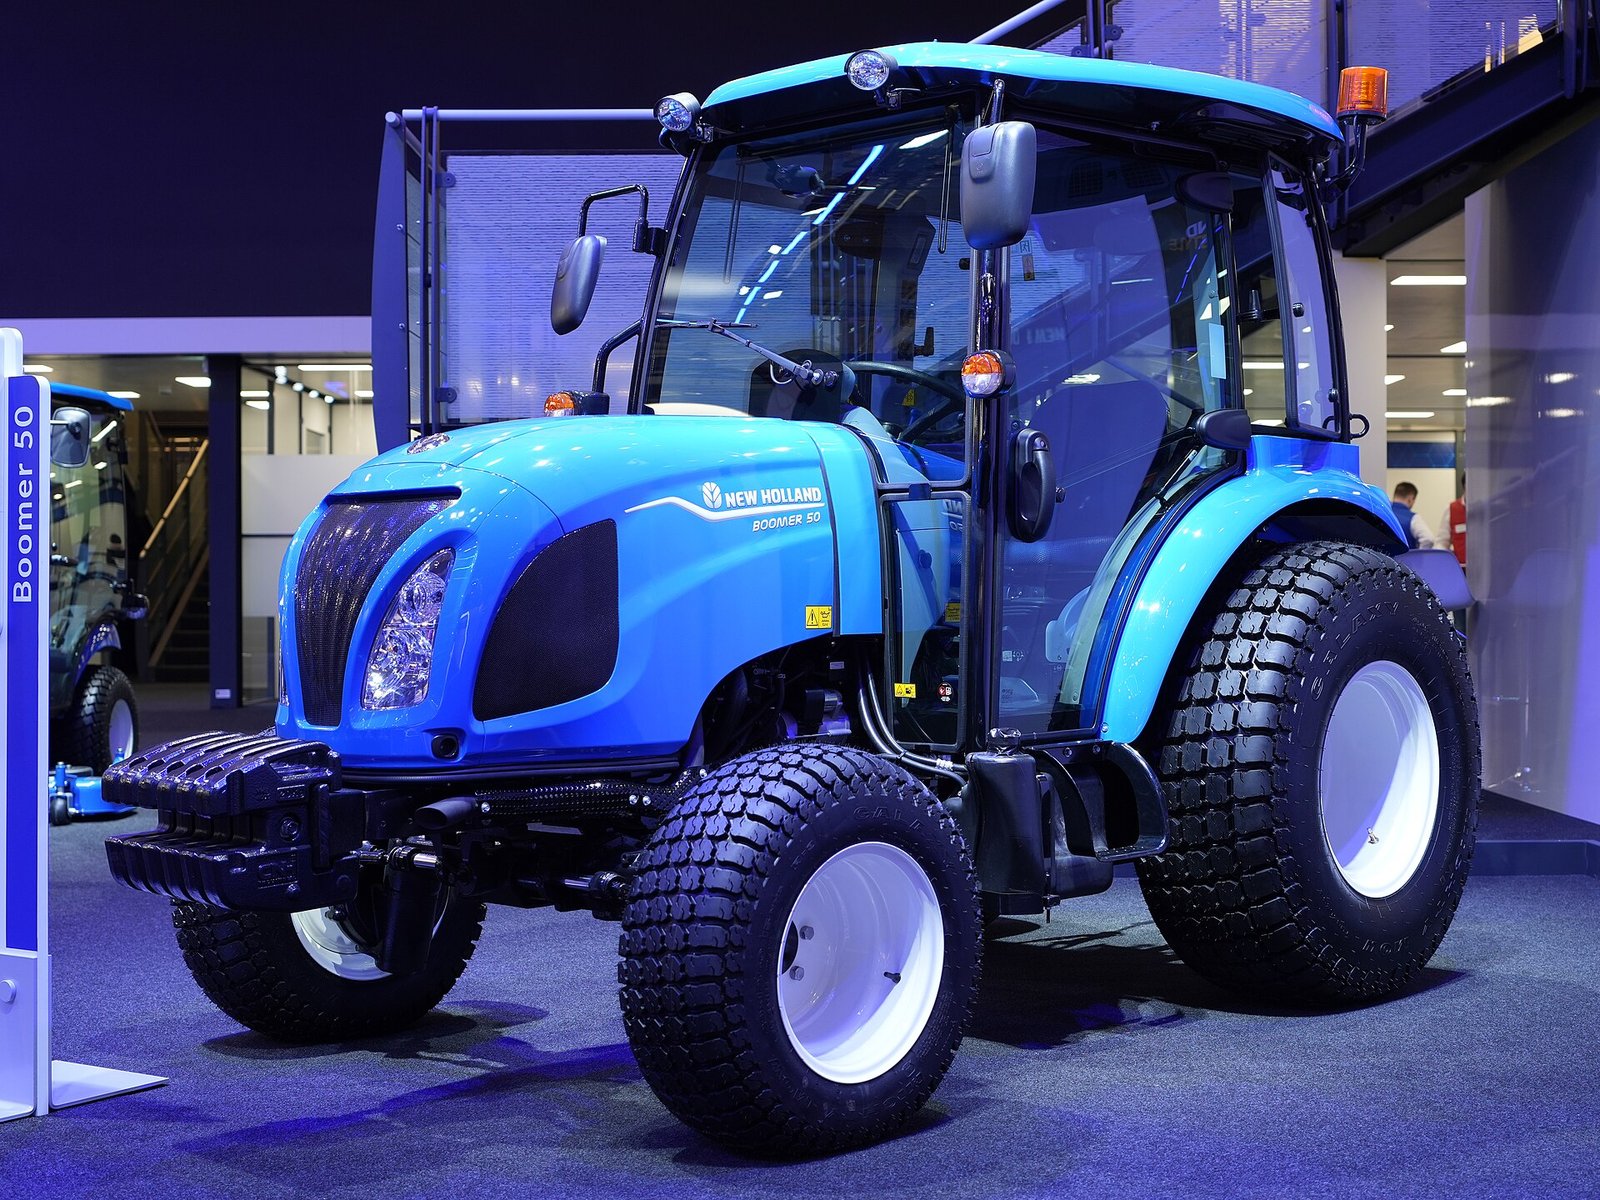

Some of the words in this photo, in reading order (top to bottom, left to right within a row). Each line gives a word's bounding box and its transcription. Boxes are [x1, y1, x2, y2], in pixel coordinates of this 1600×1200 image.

[14, 406, 34, 450] 50
[724, 489, 757, 508] NEW
[761, 487, 822, 504] HOLLAND
[12, 463, 33, 603] Boomer
[752, 514, 803, 532] BOOMER
[806, 511, 821, 524] 50
